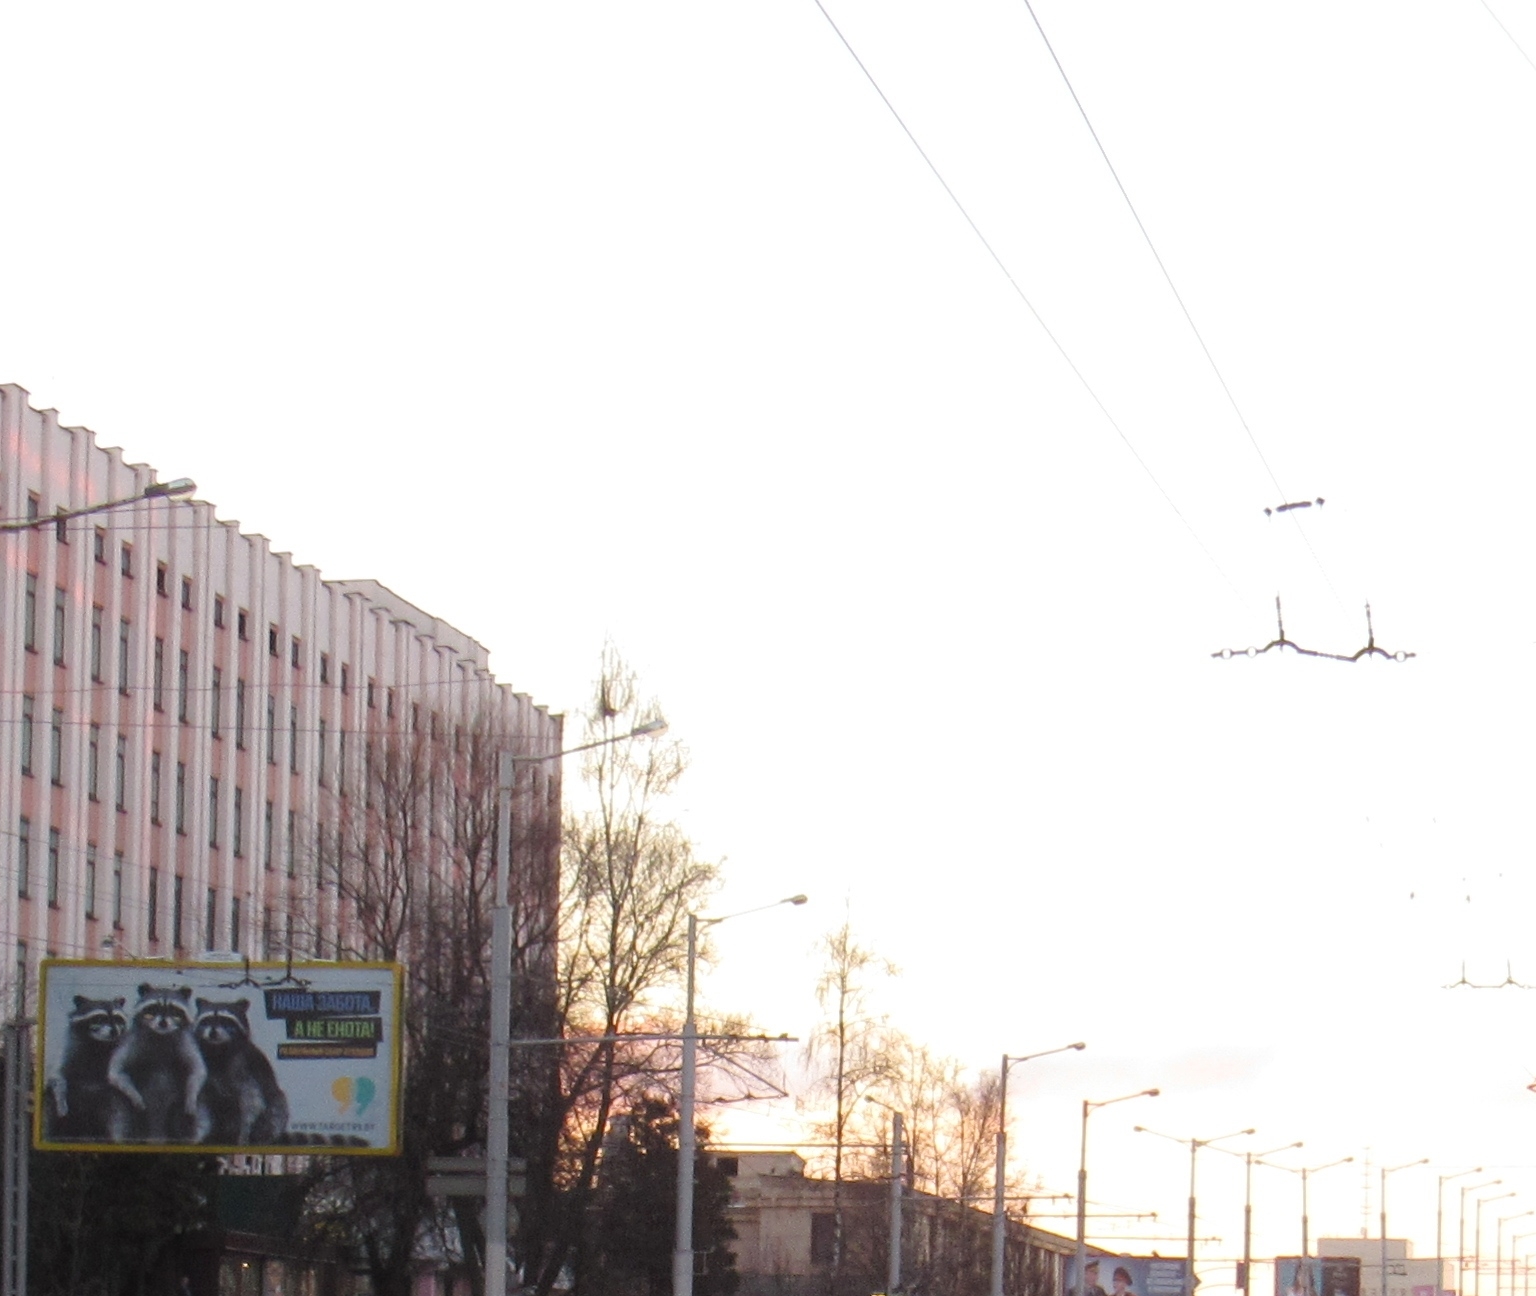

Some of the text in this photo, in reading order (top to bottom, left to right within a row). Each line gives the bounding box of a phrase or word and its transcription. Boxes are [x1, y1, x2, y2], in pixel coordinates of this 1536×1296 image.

[295, 1020, 375, 1038] А НЕ ЕНОТА!
